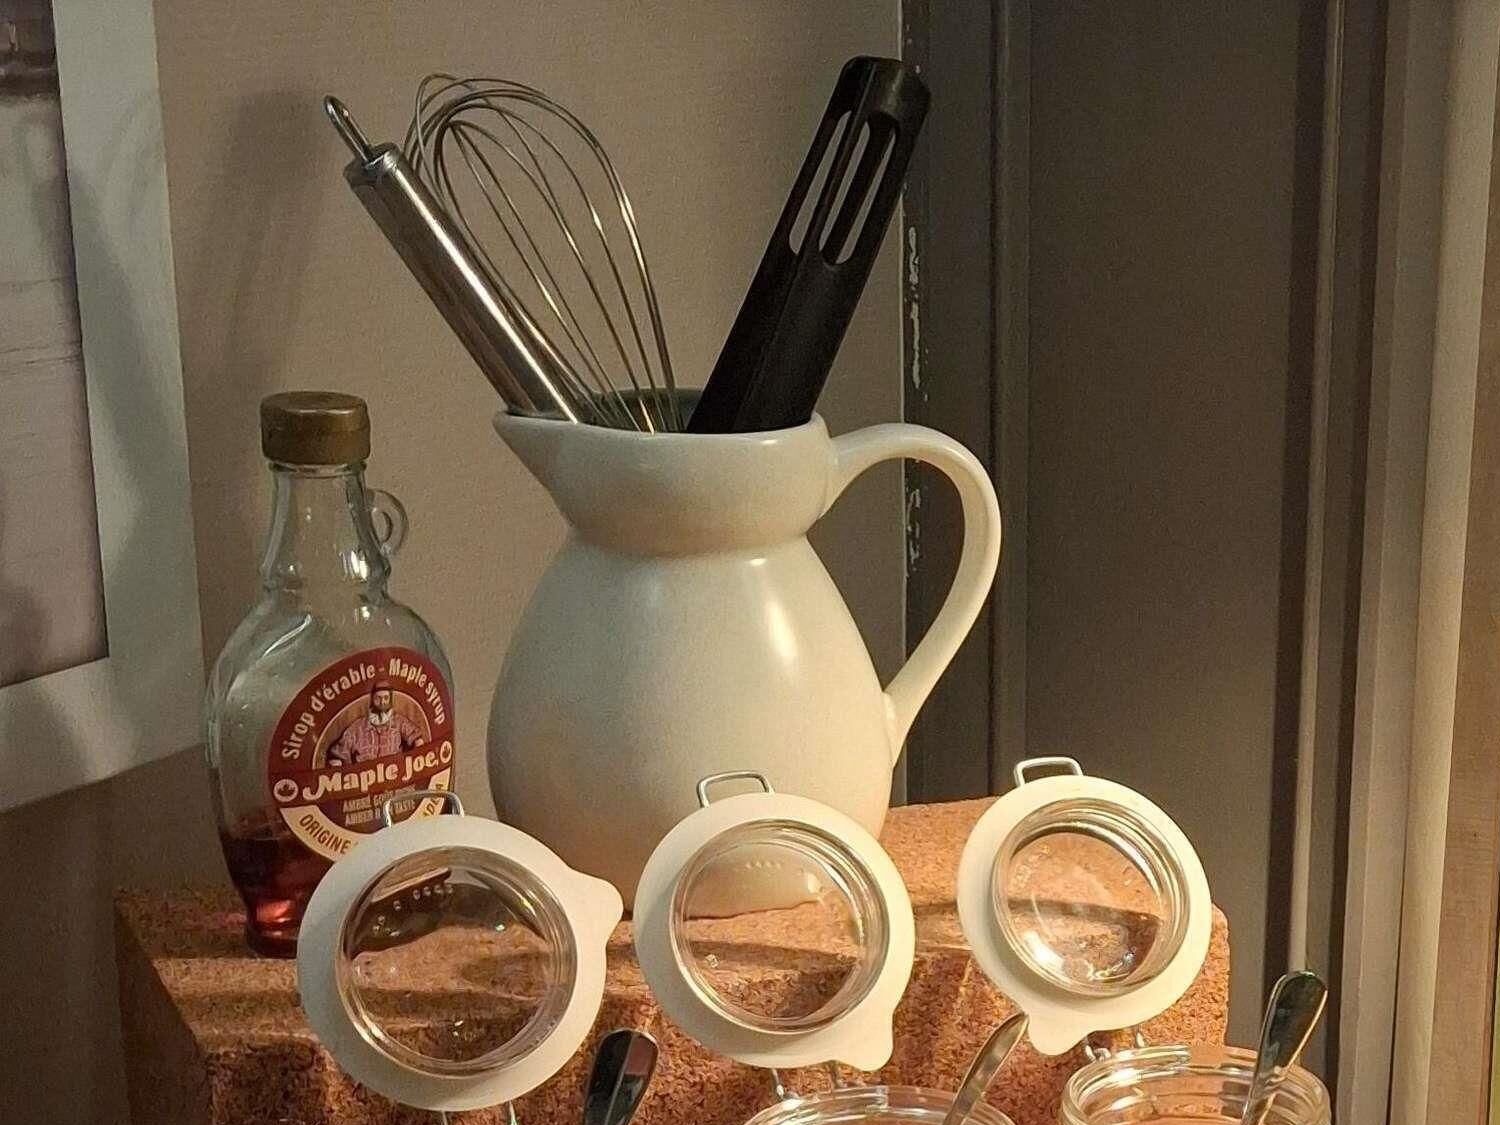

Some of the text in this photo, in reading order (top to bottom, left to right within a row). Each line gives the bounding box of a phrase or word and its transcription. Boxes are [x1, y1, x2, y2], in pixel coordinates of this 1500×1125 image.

[281, 711, 316, 760] Sirop
[310, 663, 376, 713] d'érable
[389, 658, 428, 687] Maple
[424, 681, 447, 726] syrup
[302, 763, 399, 801] Maple
[299, 813, 351, 855] ORIGINE
